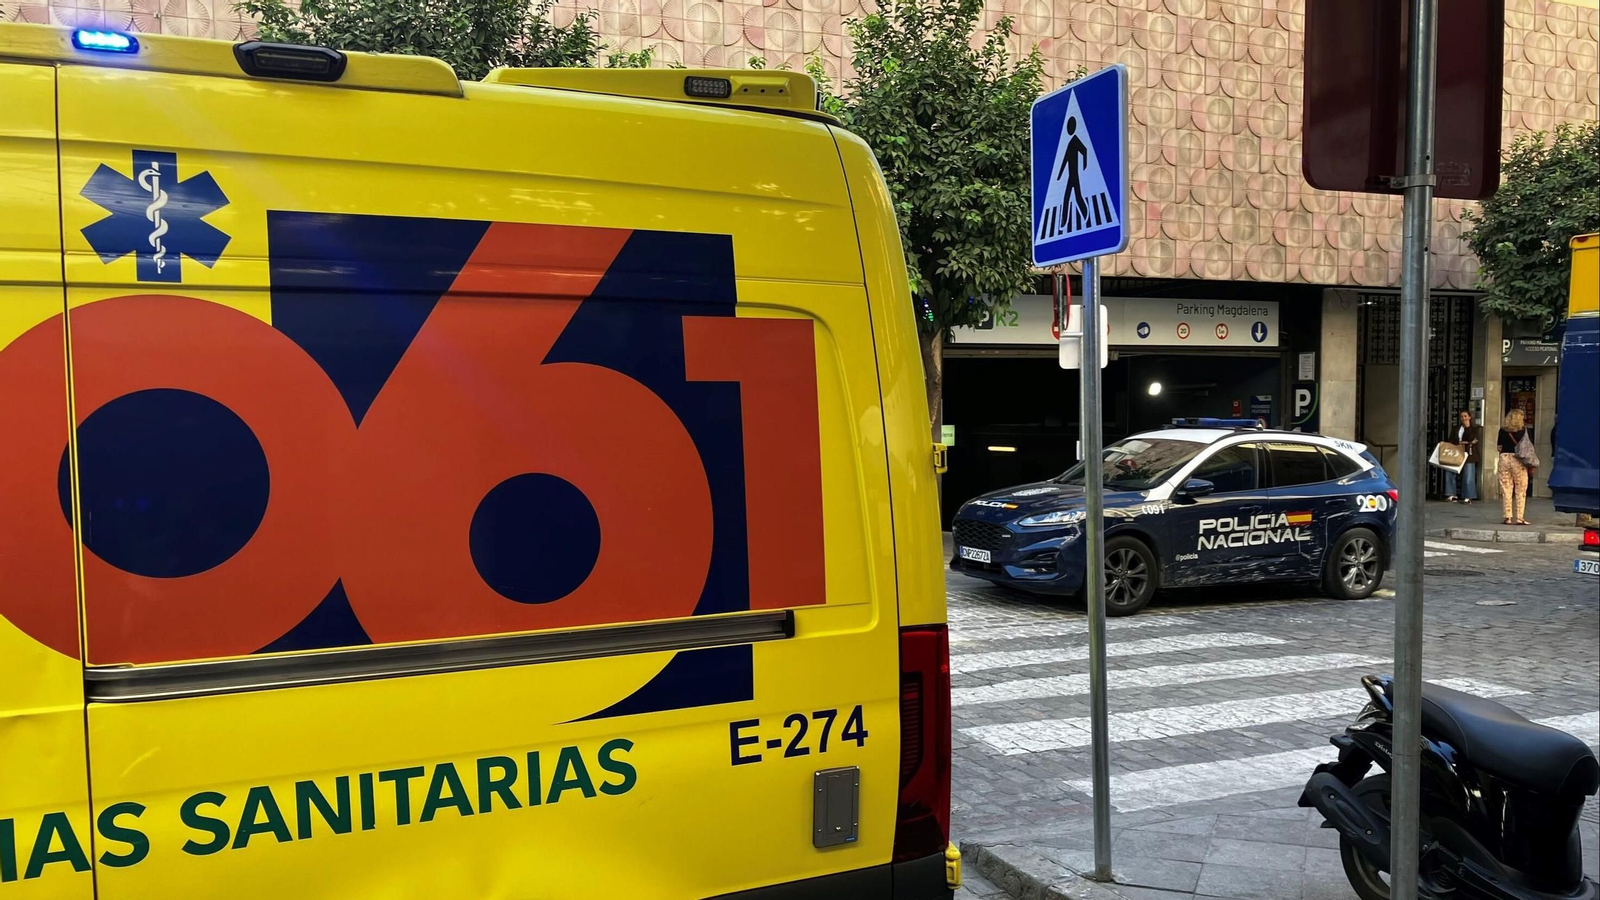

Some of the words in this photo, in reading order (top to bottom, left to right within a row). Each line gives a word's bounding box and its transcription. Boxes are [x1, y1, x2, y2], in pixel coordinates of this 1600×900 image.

[1176, 303, 1215, 318] Parking
[1217, 304, 1269, 318] Magdalena
[1295, 388, 1312, 417] P
[0, 222, 826, 666] 061
[1197, 528, 1311, 551] NACIONAL
[729, 704, 869, 767] E-274
[179, 738, 638, 856] SANITARIAS
